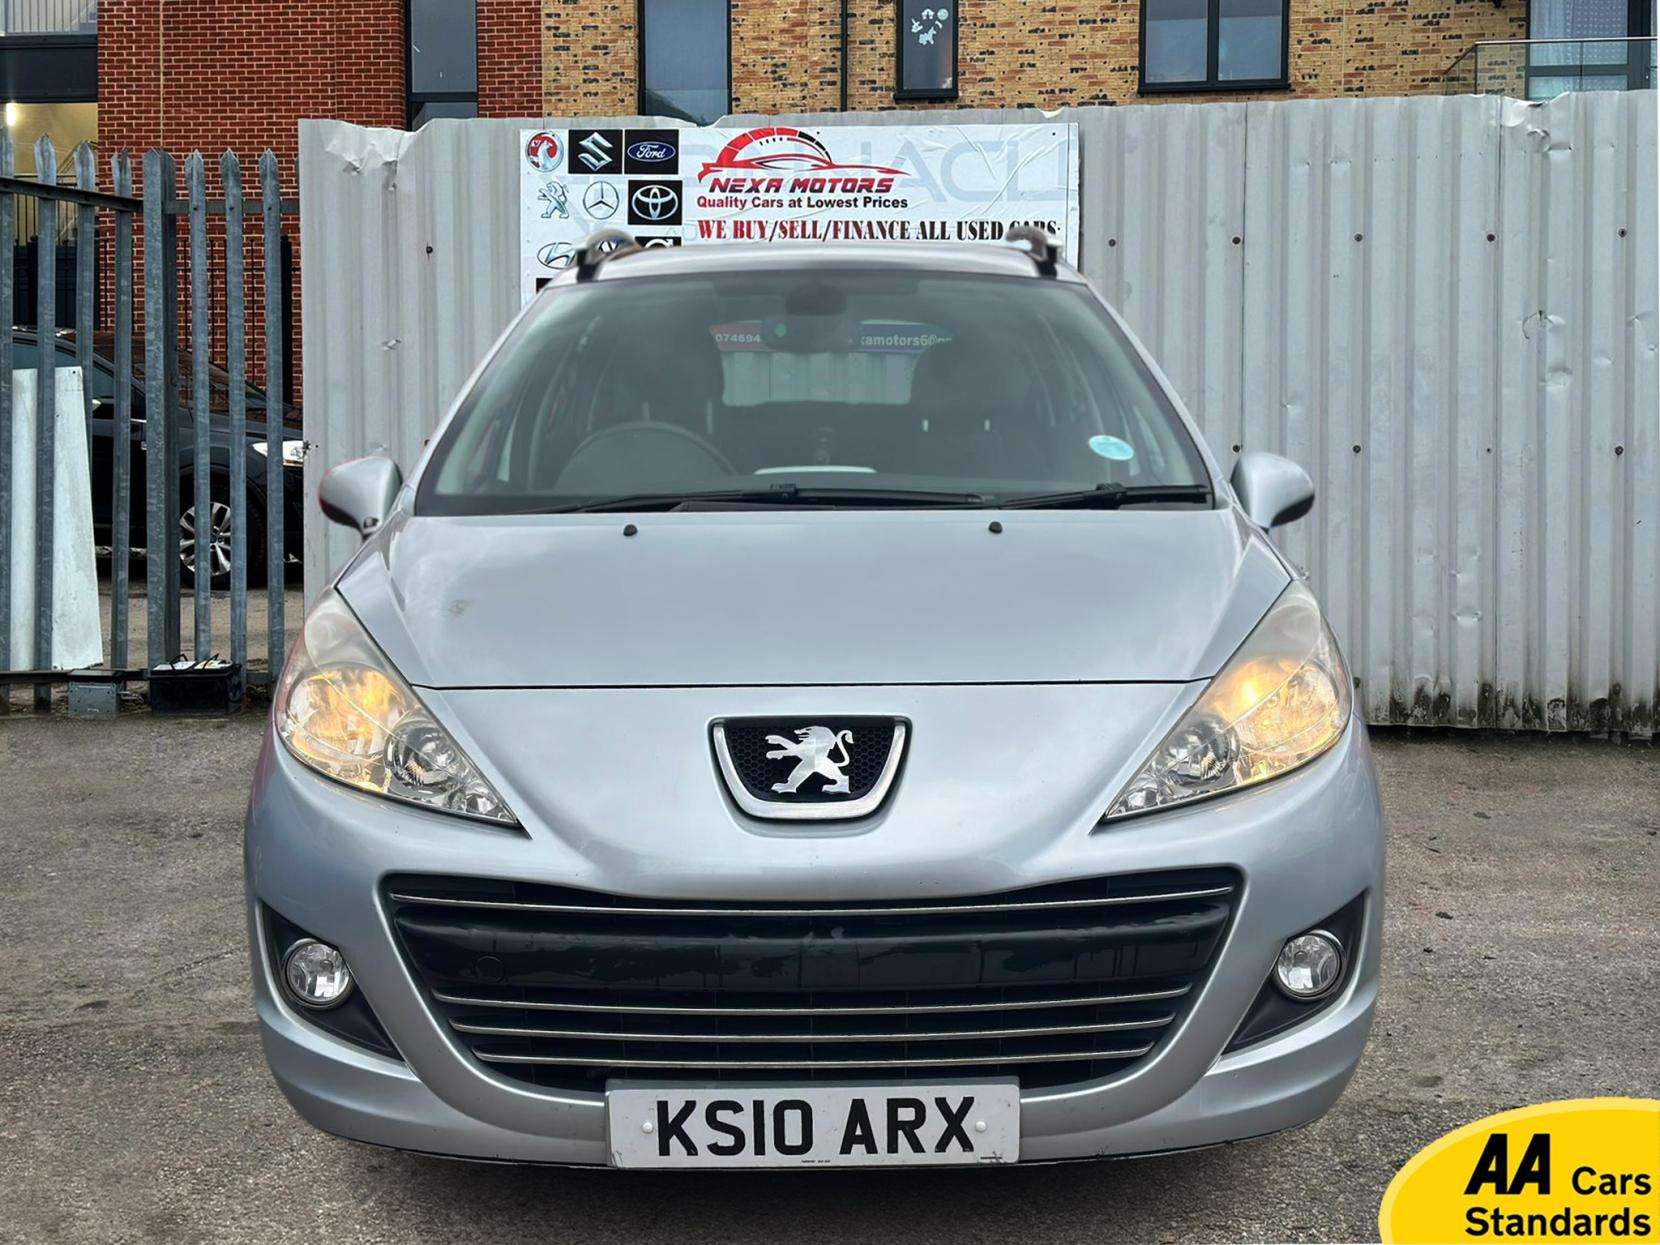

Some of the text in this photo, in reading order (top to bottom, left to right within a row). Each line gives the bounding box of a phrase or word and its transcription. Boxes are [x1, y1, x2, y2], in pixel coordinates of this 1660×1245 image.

[636, 145, 666, 158] Ford
[709, 178, 894, 193] NEXA MOTORS
[697, 196, 908, 210] Quality Cars at Lowest Prices
[698, 219, 726, 239] WE
[733, 219, 910, 242] BUY/SELL/FINANCE
[916, 220, 950, 240] ALL
[957, 220, 1004, 240] USED
[656, 1096, 975, 1157] KS10 ARX
